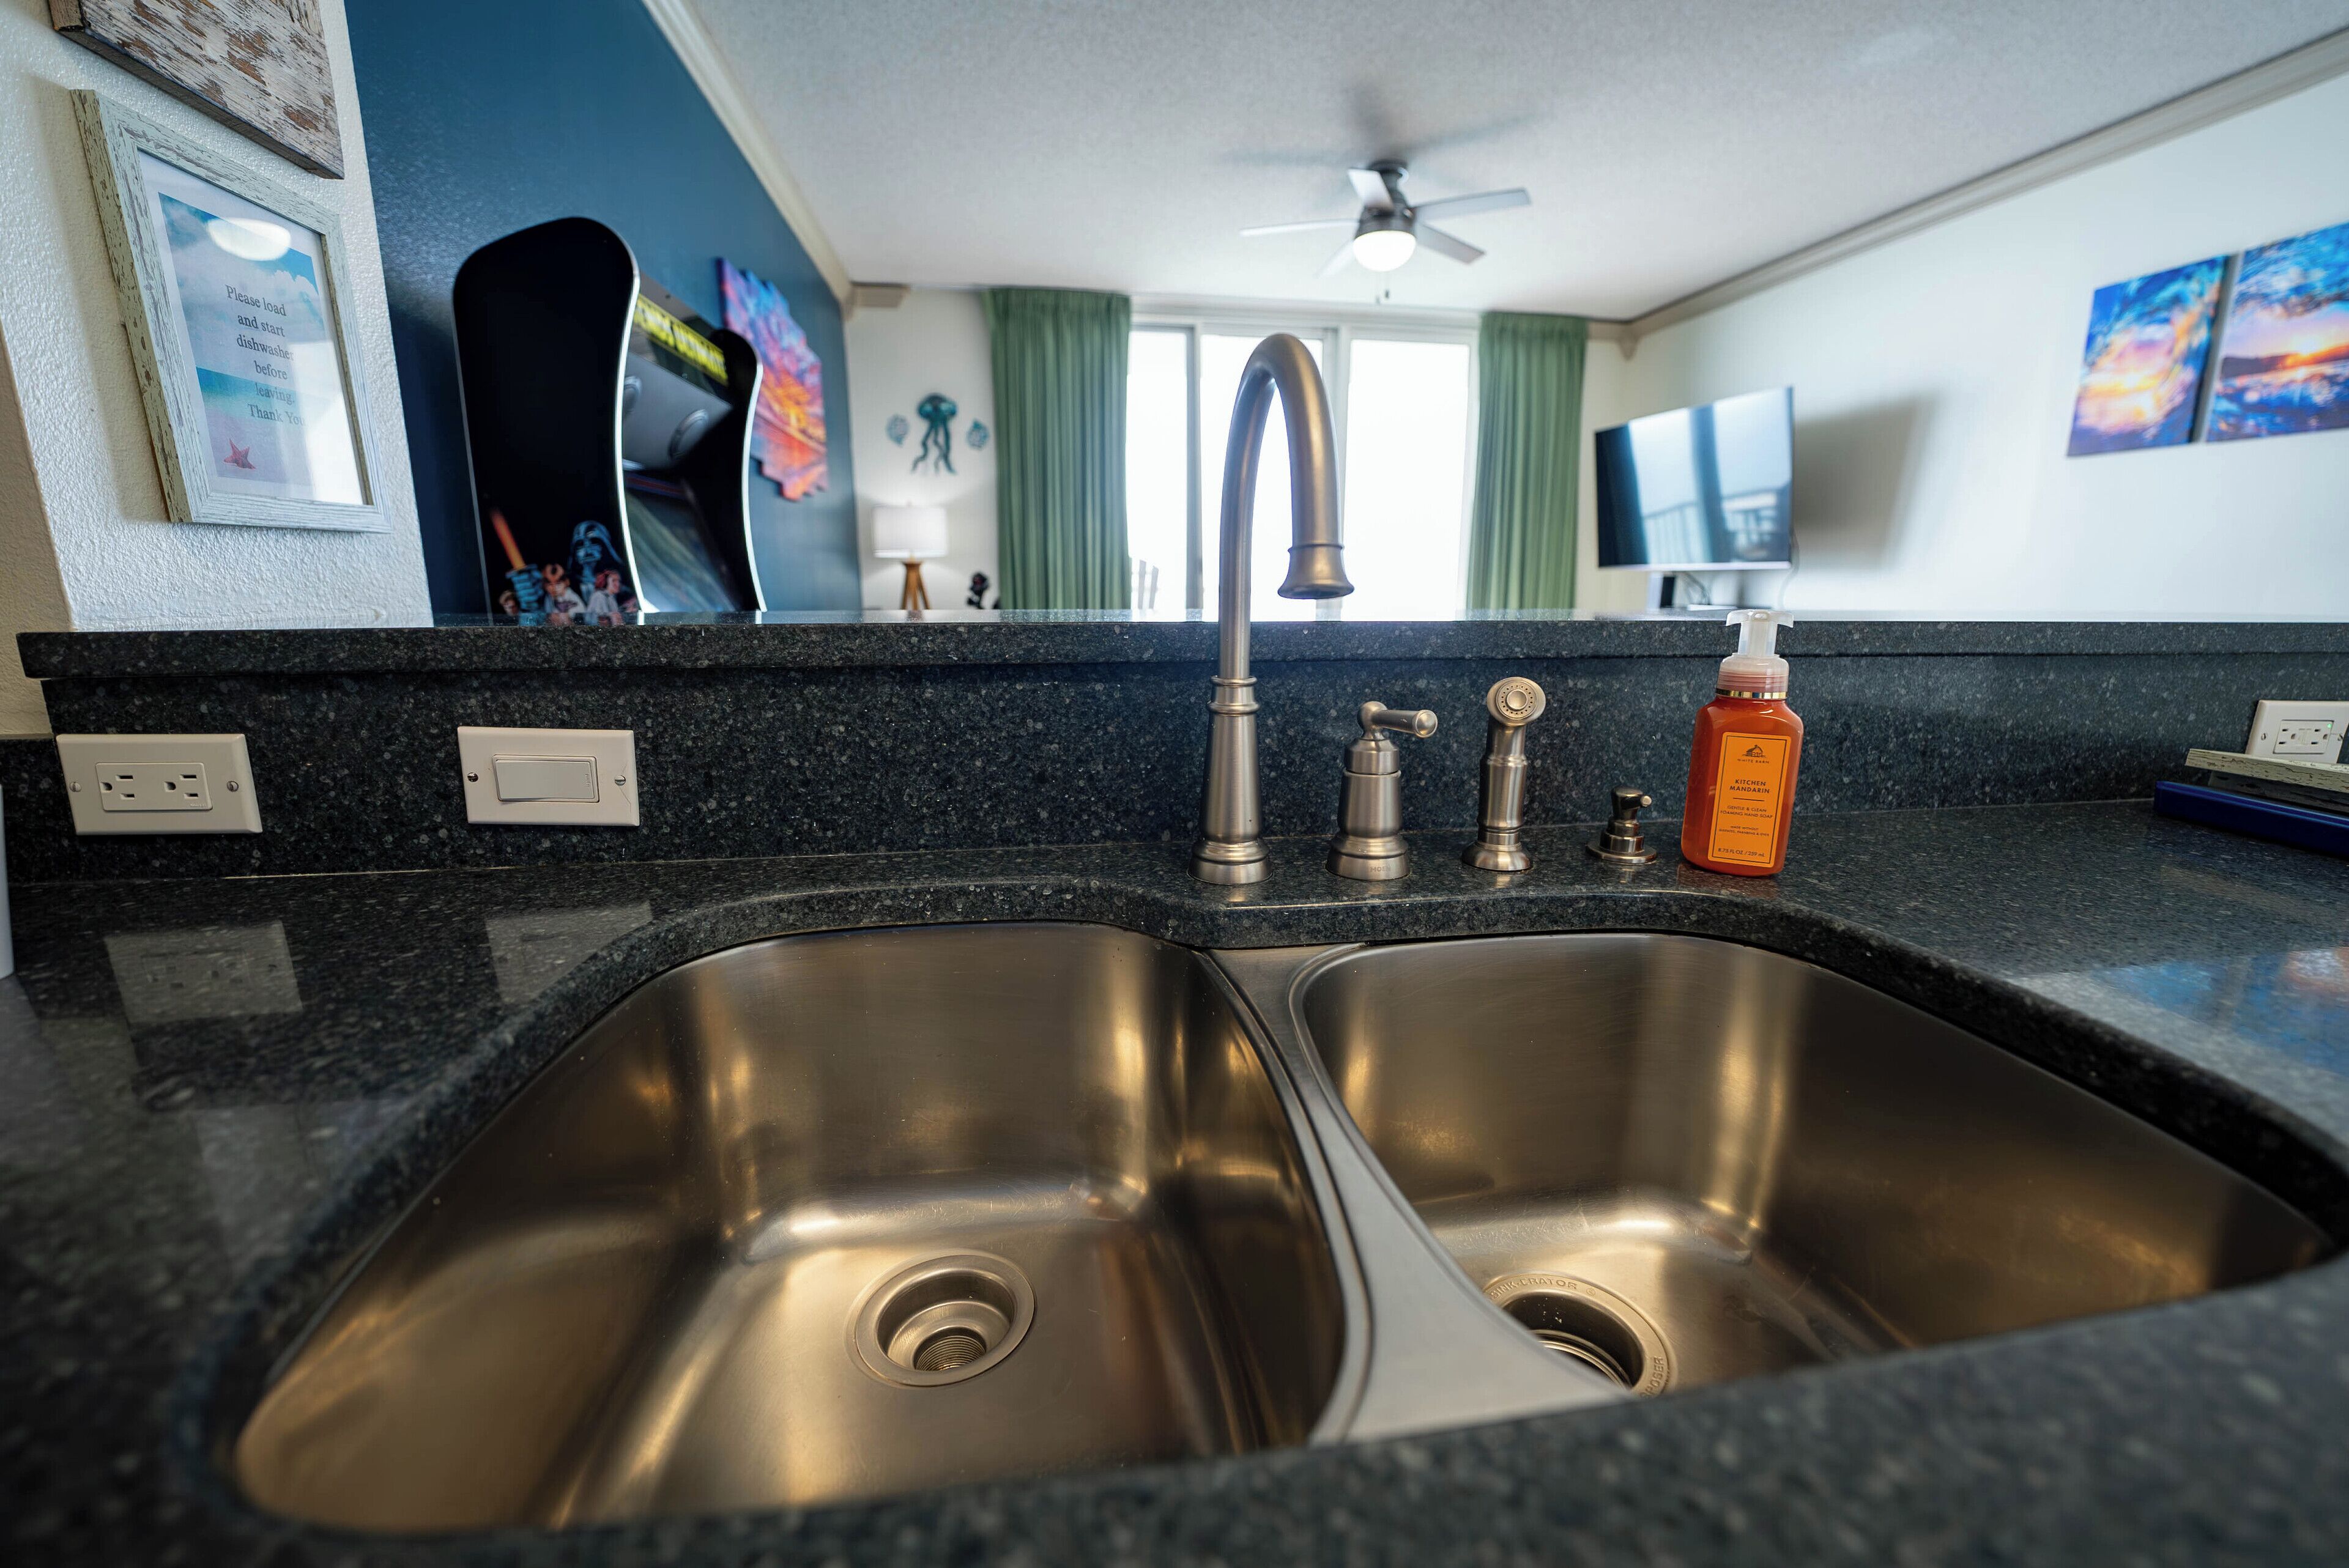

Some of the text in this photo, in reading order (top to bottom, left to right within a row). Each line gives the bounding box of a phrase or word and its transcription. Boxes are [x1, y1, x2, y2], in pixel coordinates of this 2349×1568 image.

[225, 284, 286, 316] Please load
[237, 315, 285, 337] and start
[254, 360, 288, 380] before
[248, 404, 283, 422] Thank
[1729, 785, 1770, 794] MANDARIN
